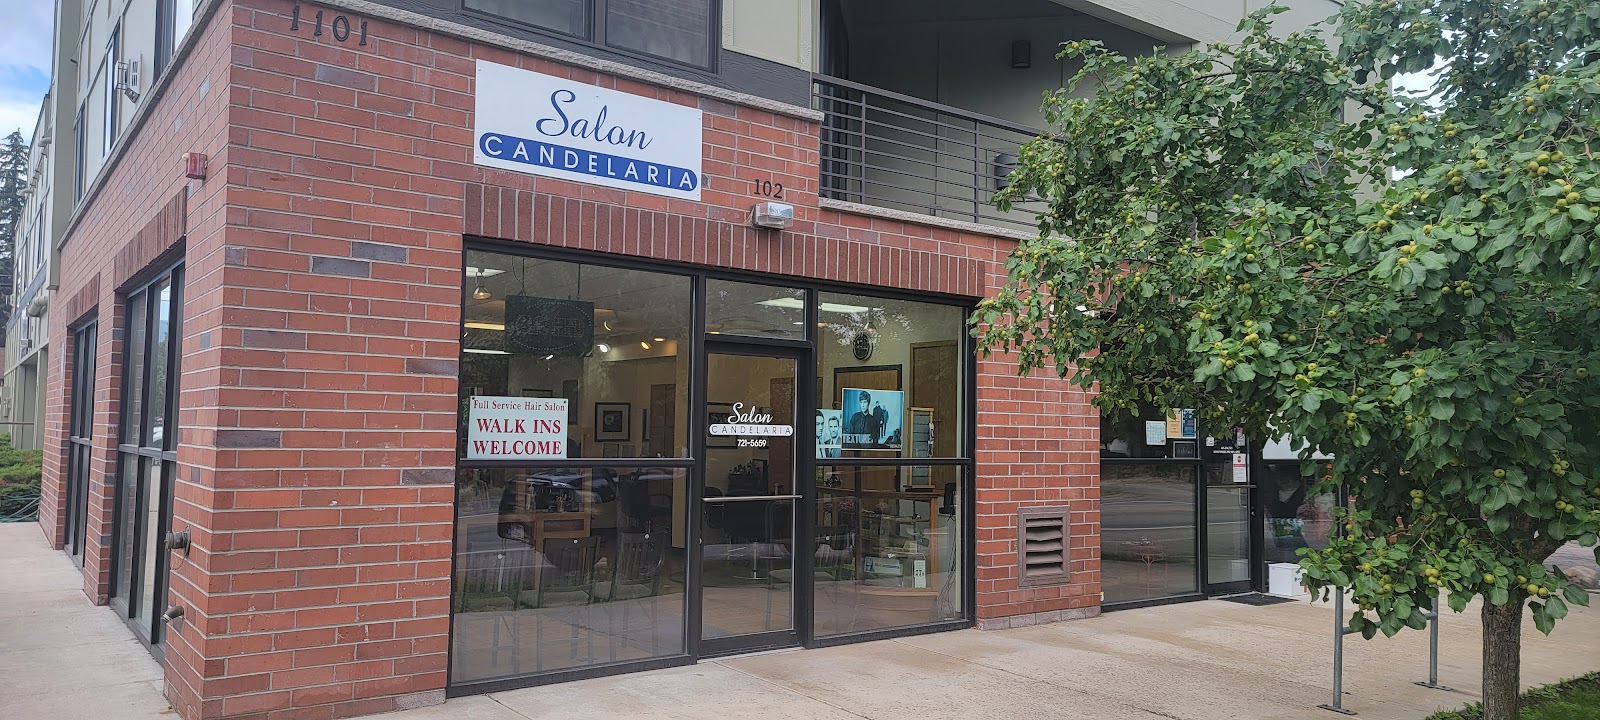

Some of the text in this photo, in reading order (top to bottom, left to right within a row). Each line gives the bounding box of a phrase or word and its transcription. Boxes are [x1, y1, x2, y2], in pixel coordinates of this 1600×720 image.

[290, 5, 368, 46] 1101
[535, 89, 654, 150] Salon
[483, 135, 694, 190] CANDELARIA
[753, 178, 783, 199] 102
[472, 400, 565, 412] Full Service Hair Salon
[727, 402, 774, 424] Salon
[476, 418, 561, 434] WALK INS
[711, 425, 791, 435] CANDELARIA
[473, 440, 563, 456] WELCOME
[737, 439, 767, 447] 721-5659
